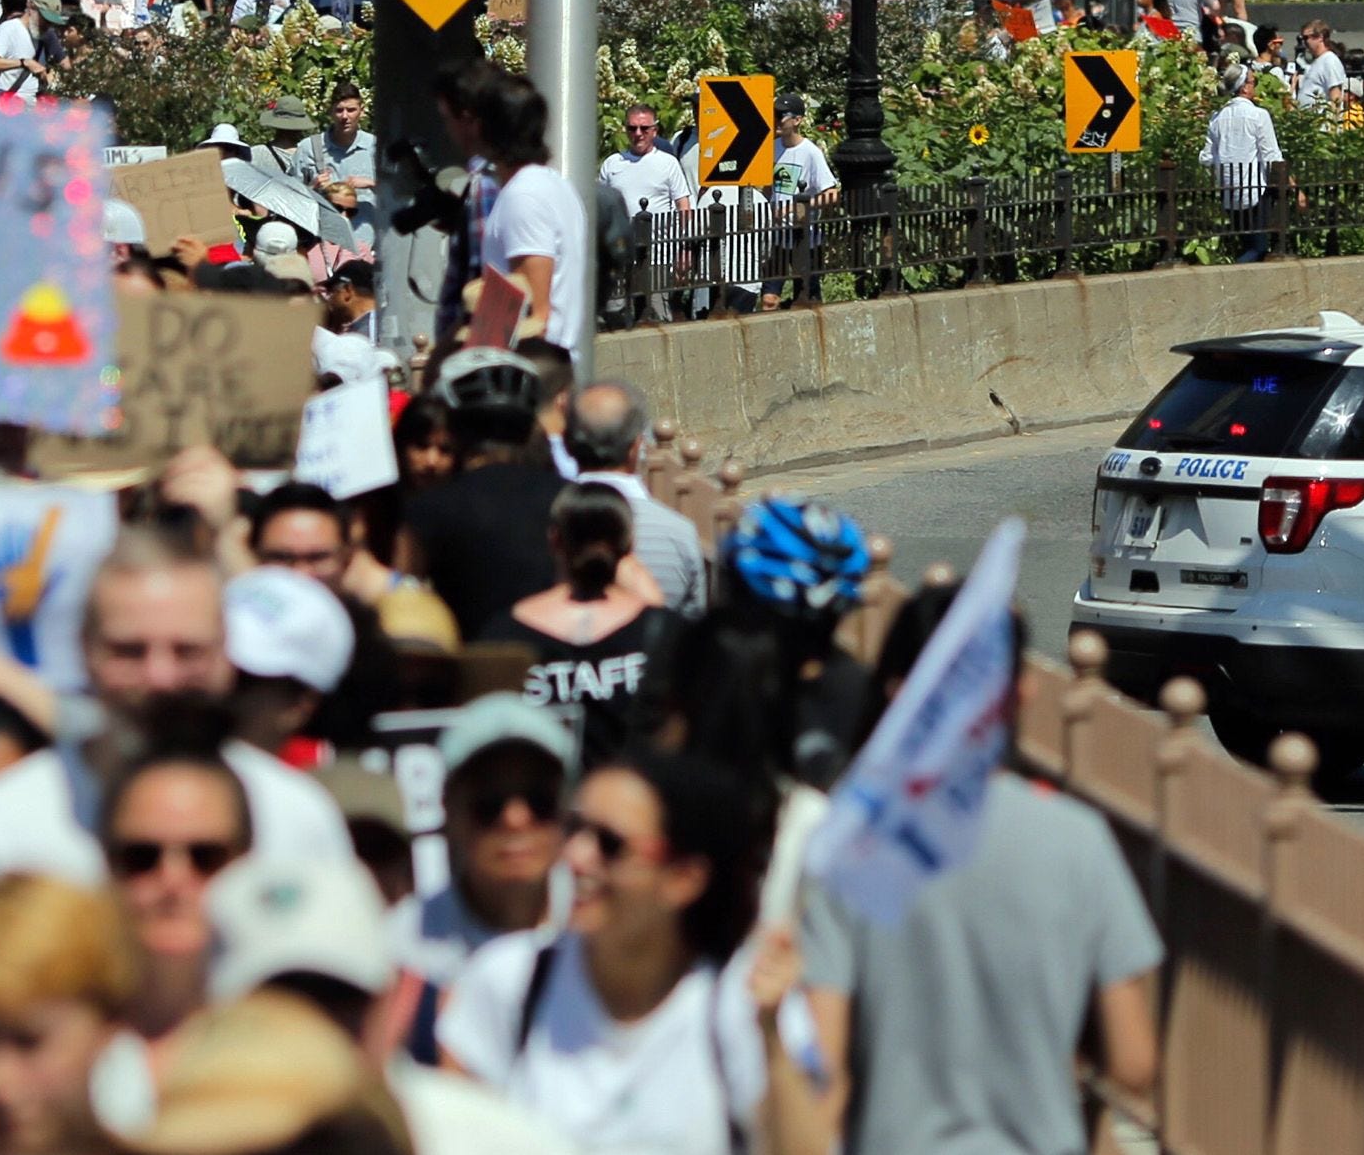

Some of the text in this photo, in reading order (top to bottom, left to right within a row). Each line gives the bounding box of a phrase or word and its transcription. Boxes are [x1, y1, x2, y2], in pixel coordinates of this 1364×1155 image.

[148, 300, 234, 361] DO
[1174, 457, 1250, 481] POLICE
[523, 651, 648, 707] STAFF
